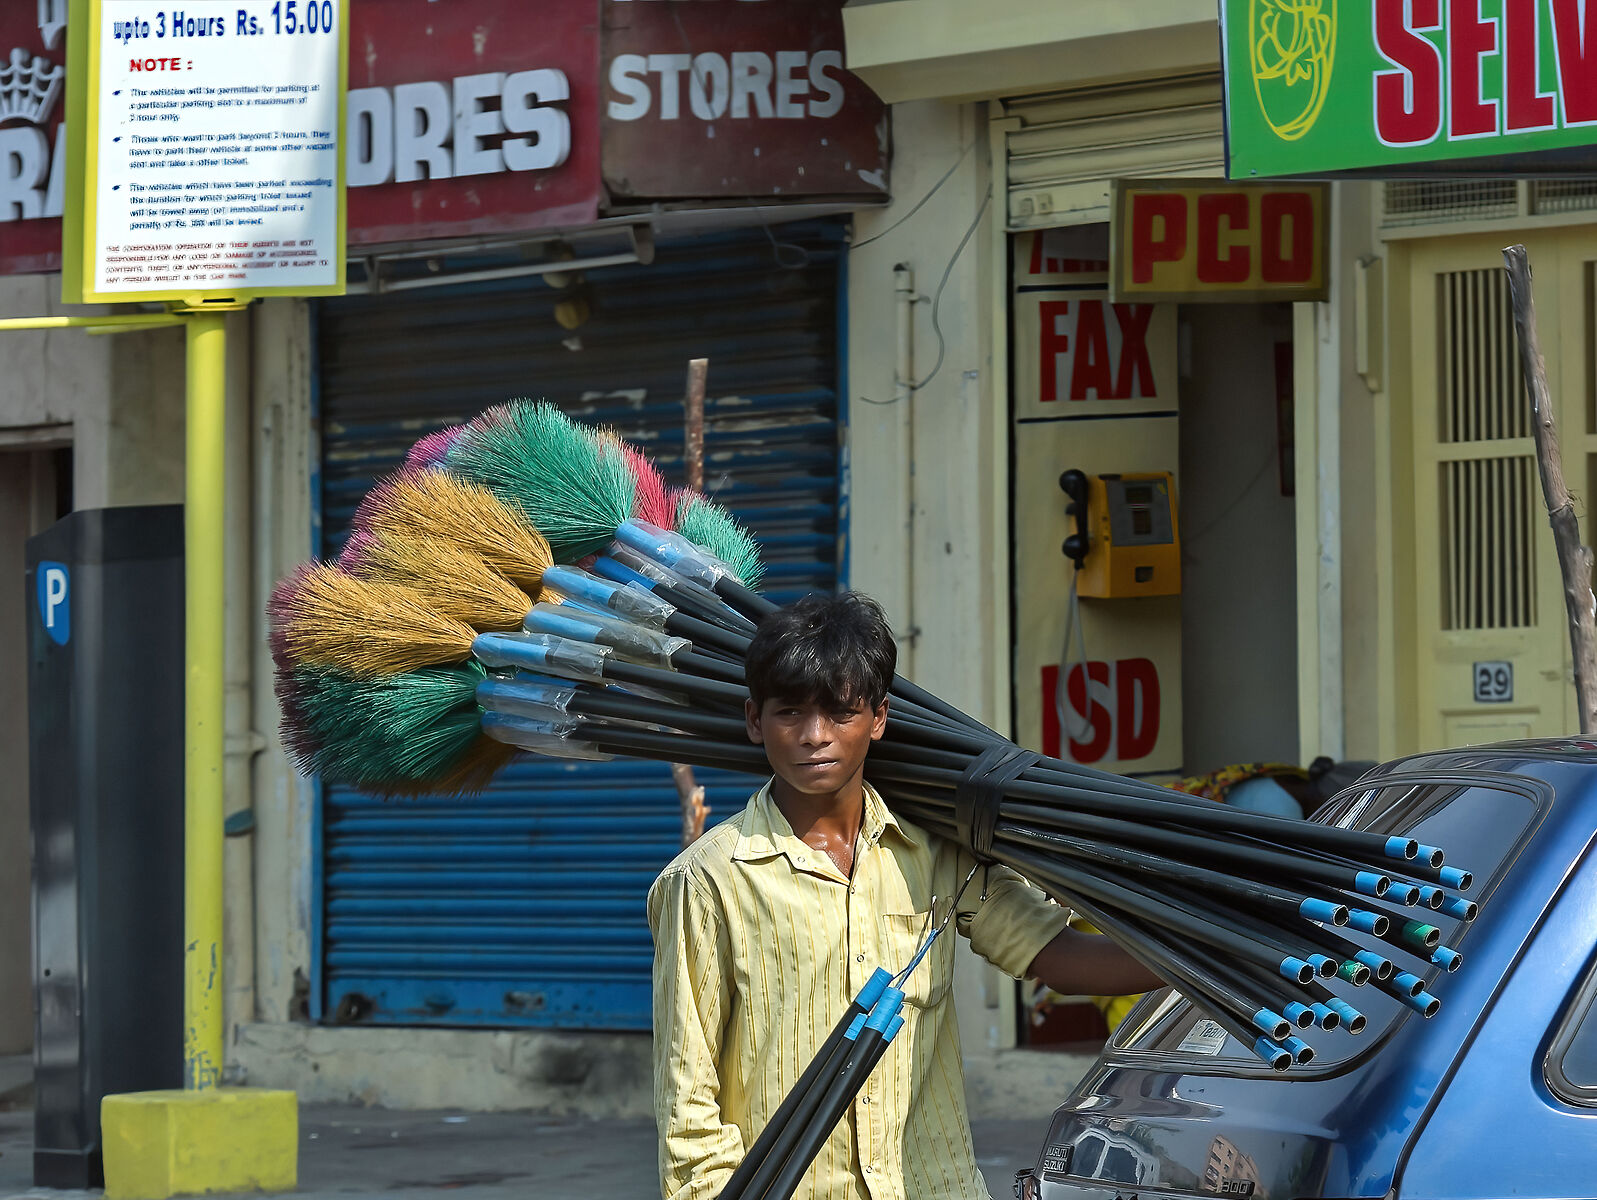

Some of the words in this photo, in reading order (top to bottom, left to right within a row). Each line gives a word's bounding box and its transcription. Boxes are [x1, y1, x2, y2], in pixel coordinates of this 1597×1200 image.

[156, 12, 166, 38] 3
[172, 11, 224, 37] Hours
[236, 9, 264, 35] Rs.
[271, 0, 332, 34] 15.00
[130, 58, 181, 72] NOTE
[608, 50, 845, 121] STORES
[1132, 193, 1315, 284] PCO
[1039, 299, 1158, 402] FAX
[46, 568, 67, 627] P
[1041, 657, 1161, 764] ISD
[1479, 668, 1508, 696] 29
